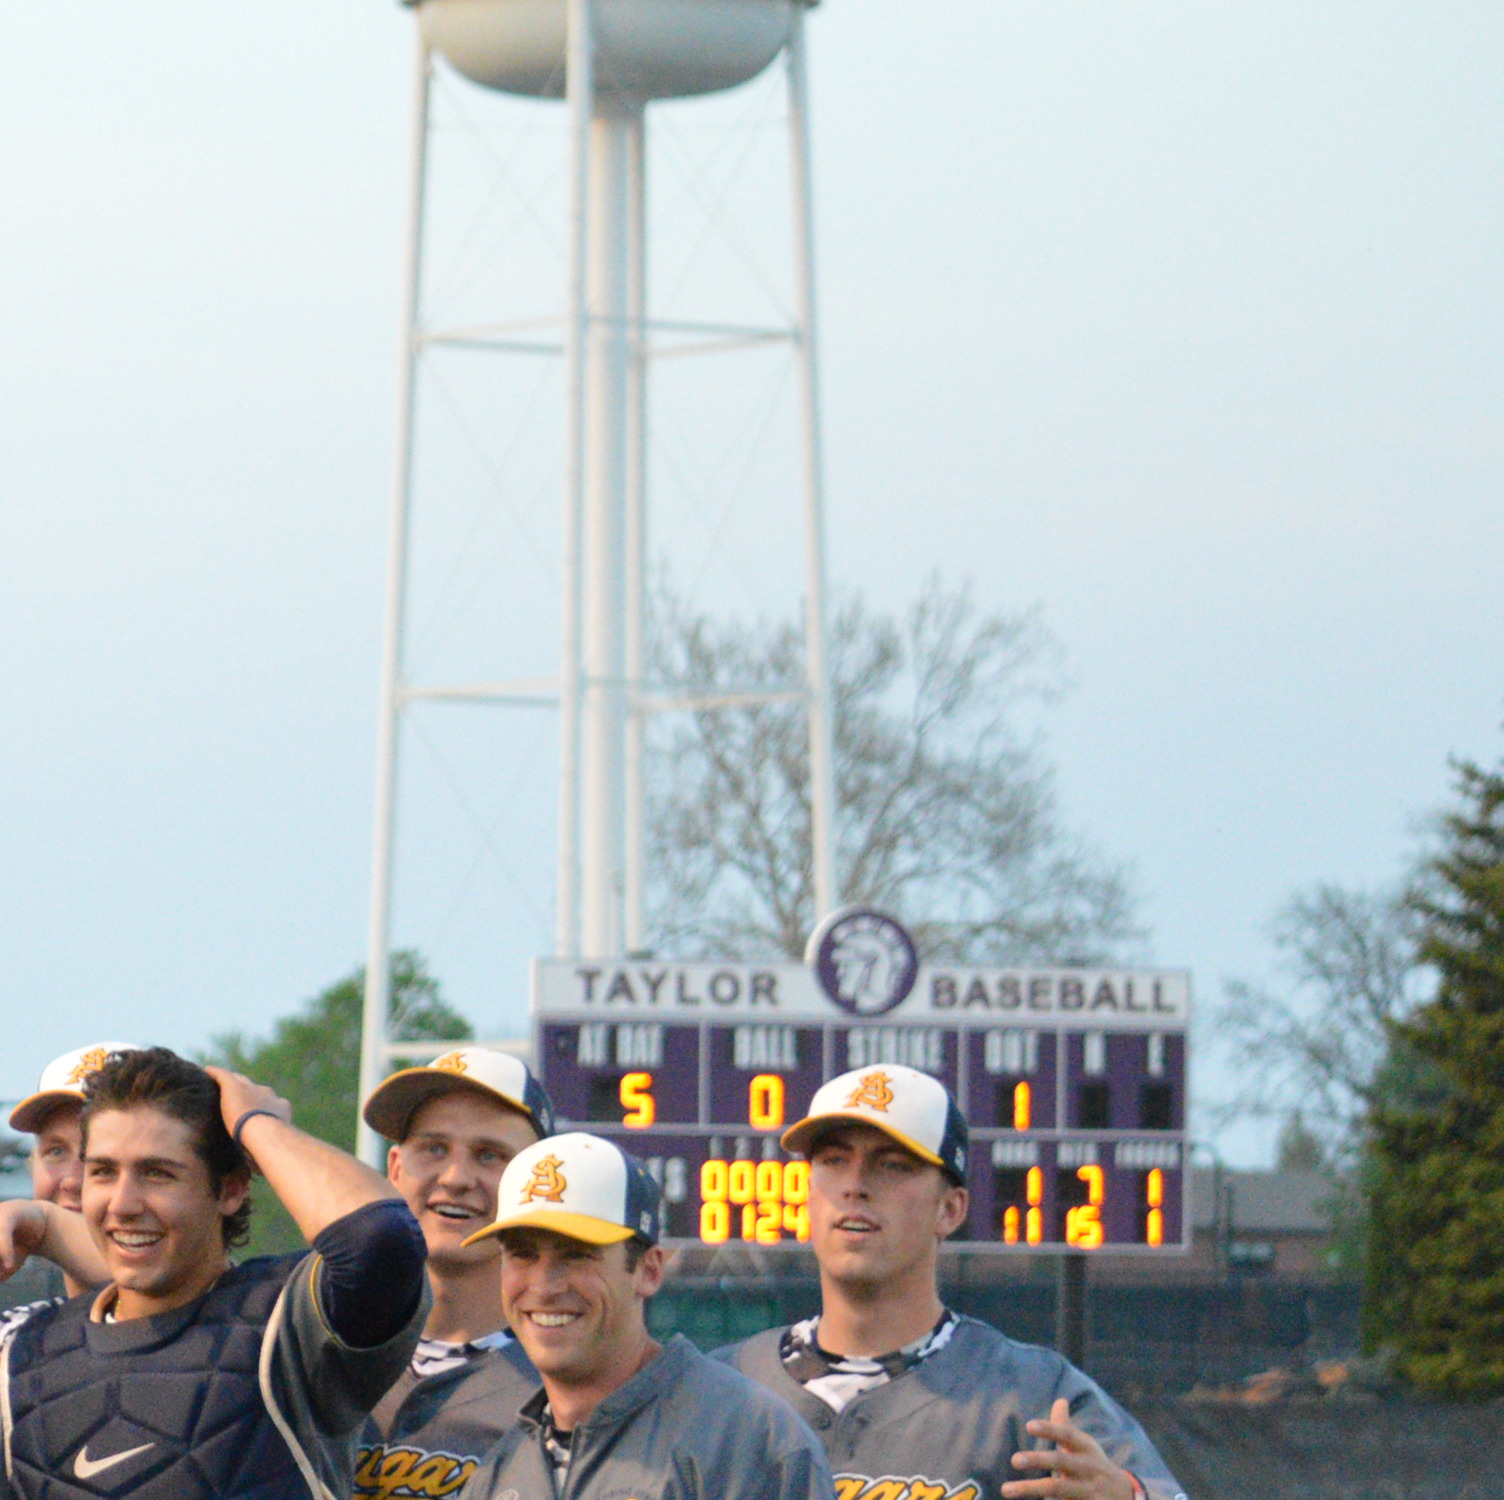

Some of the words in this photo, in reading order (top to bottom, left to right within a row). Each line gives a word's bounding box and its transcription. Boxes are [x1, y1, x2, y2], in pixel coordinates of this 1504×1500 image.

[576, 968, 779, 1006] TAYLOR
[930, 976, 1177, 1014] BASEBALL
[619, 1072, 656, 1130] 5
[749, 1074, 785, 1131] 0
[1013, 1081, 1031, 1132] 1
[1026, 1166, 1042, 1206] 1
[1077, 1165, 1104, 1206] 7
[1147, 1167, 1163, 1208] 1
[1147, 1207, 1162, 1248] 1
